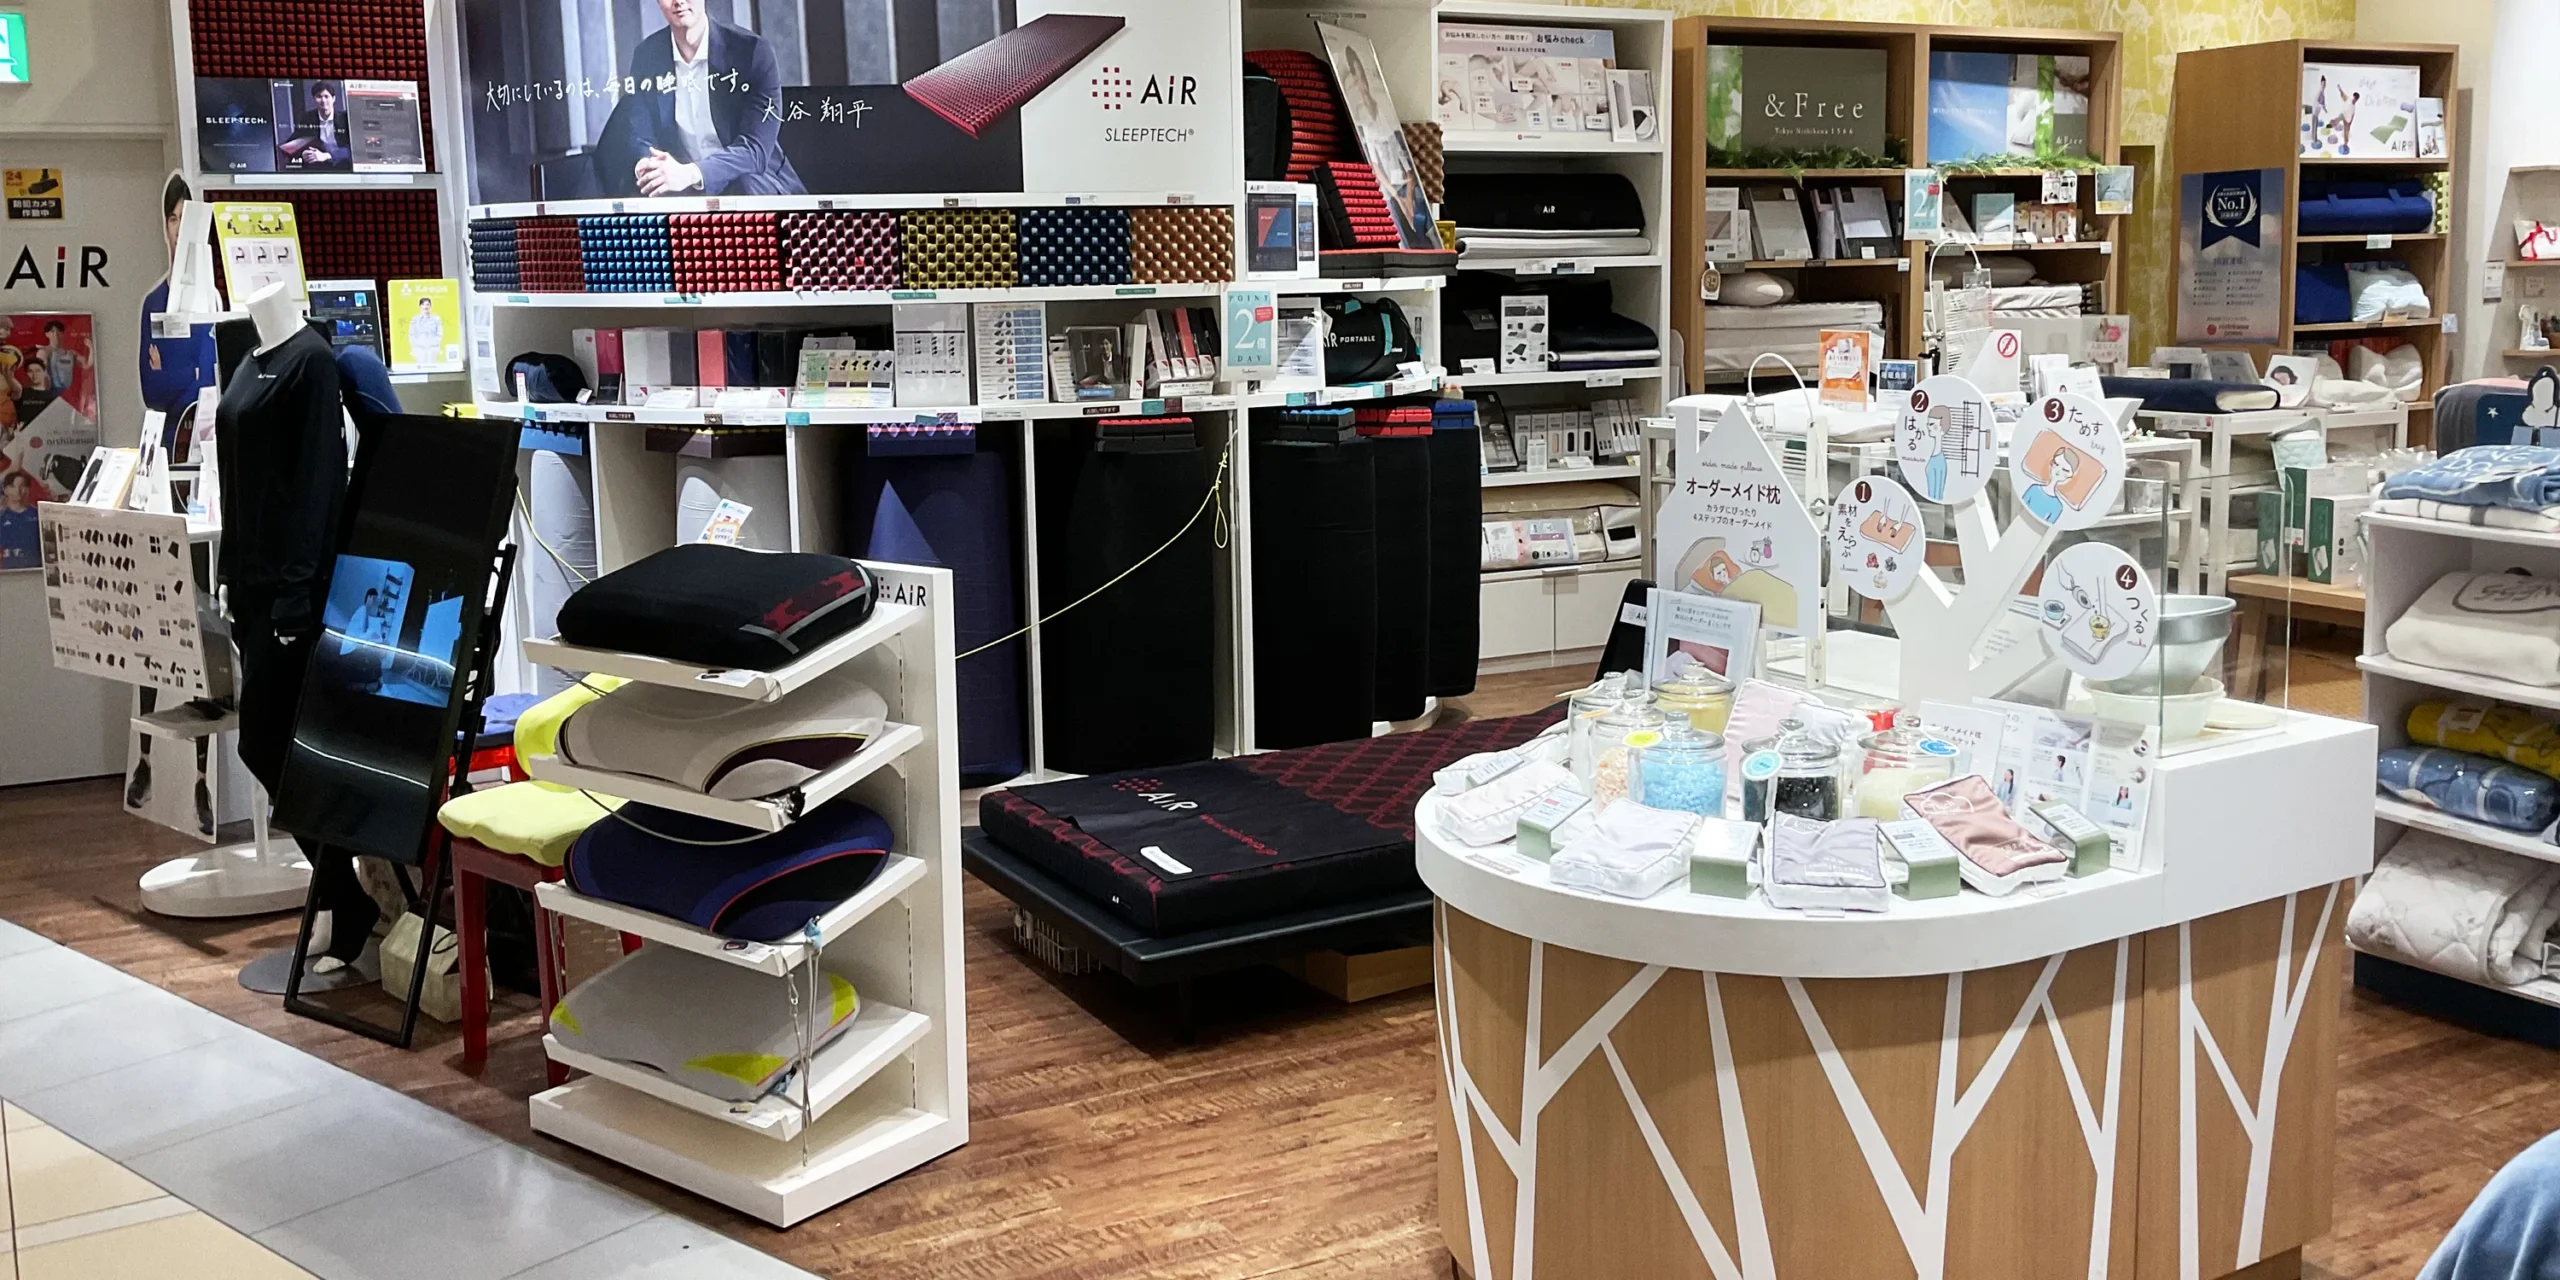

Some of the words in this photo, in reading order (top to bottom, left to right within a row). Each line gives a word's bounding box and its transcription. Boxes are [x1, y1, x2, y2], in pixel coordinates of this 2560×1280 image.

[486, 68, 750, 112] 大切にしているのは、毎日の睡眠です。
[13, 199, 56, 208] 防犯カメラ
[22, 209, 50, 217] 作動中
[2217, 196, 2245, 211] No.1
[4, 244, 110, 290] AiR
[1340, 335, 1376, 343] PORTABLE
[1238, 355, 1262, 363] DAY
[1905, 416, 1926, 451] はかる
[2068, 406, 2103, 436] ためす
[1686, 477, 1781, 505] オーダーメイド枕
[1693, 513, 1773, 530] 4ステップのオーダーメイド
[1838, 503, 1857, 558] 素材をえらぶ
[894, 582, 926, 607] AiR
[2126, 597, 2148, 635] つくる
